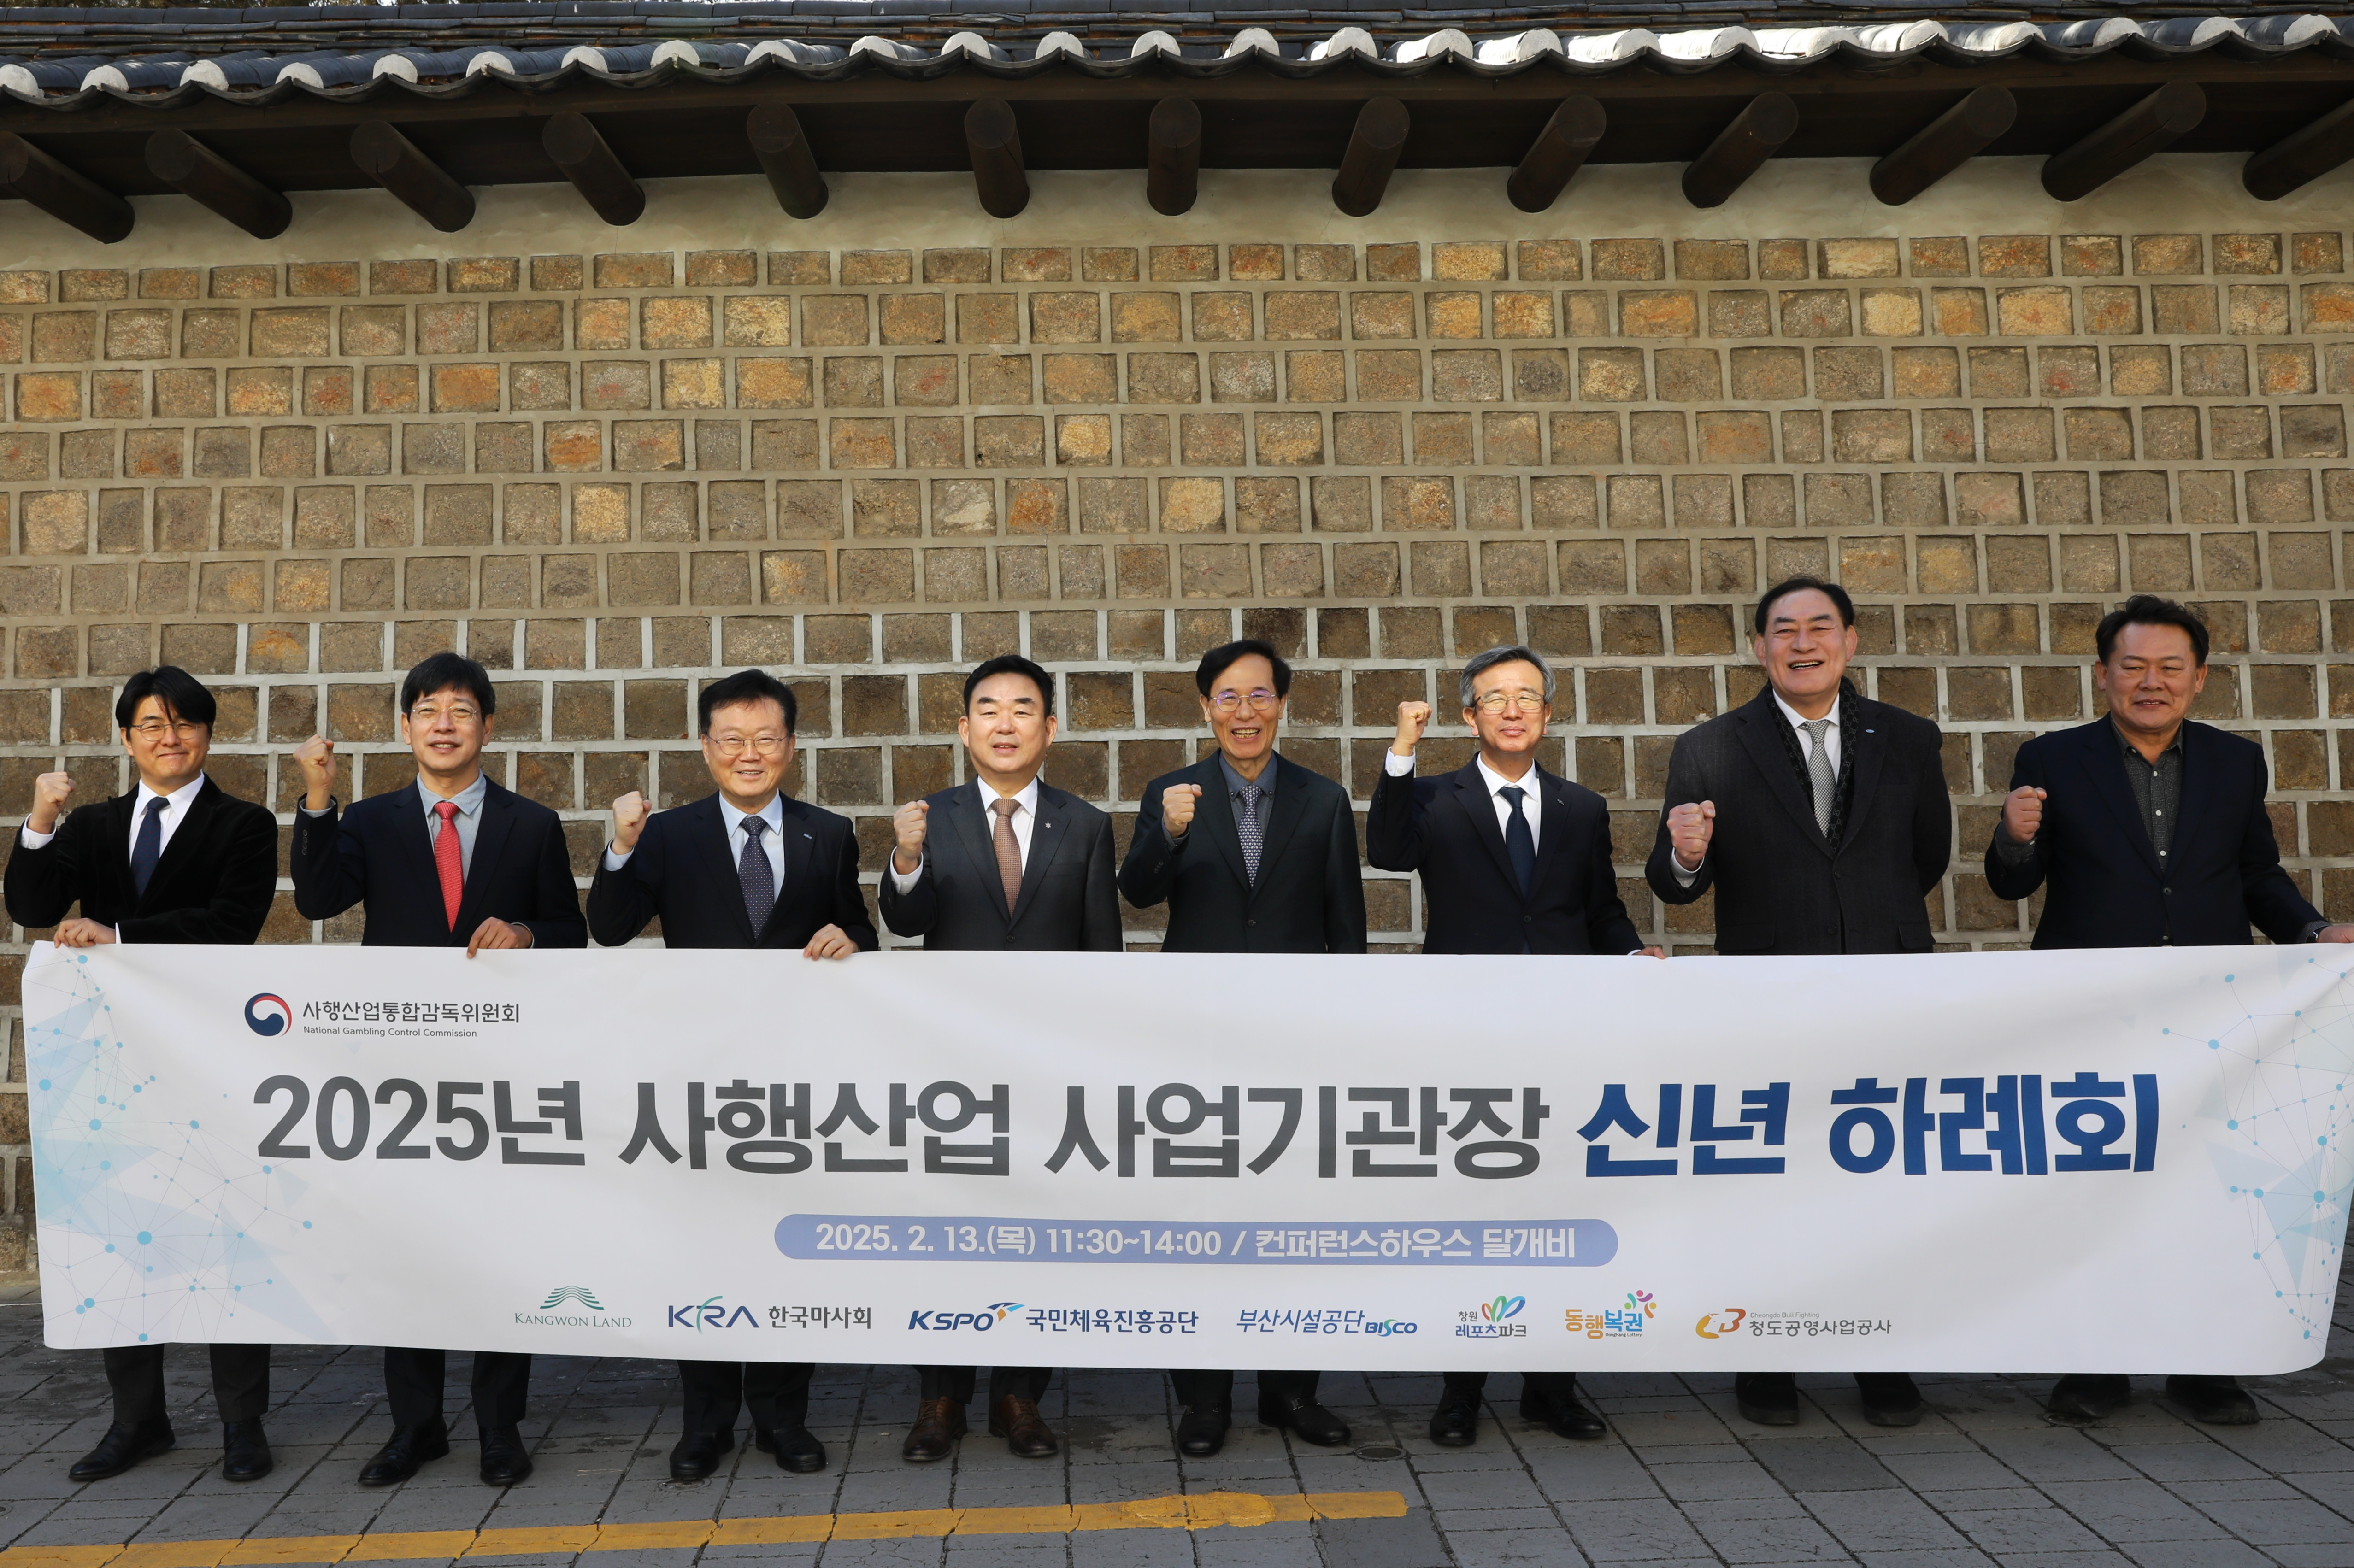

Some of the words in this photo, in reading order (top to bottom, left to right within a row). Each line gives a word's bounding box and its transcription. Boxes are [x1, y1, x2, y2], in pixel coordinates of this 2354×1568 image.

[302, 1001, 519, 1023] 사행산업통합감독위원회
[304, 1026, 340, 1035] National
[342, 1027, 385, 1037] Gambling
[388, 1028, 420, 1036] Control
[423, 1028, 477, 1037] Commission
[253, 1075, 586, 1166] 2025년
[618, 1079, 1010, 1176] 사행산업
[1043, 1082, 1550, 1180] 사업기관장
[1576, 1082, 1791, 1178] 신년
[1829, 1072, 2159, 1175] 하례회
[816, 1223, 898, 1251] 2025.
[908, 1225, 934, 1251] 2.
[944, 1225, 1036, 1255] 13.(목)
[1046, 1229, 1221, 1256] 11:30~14:00
[1230, 1230, 1247, 1256] /
[1255, 1228, 1472, 1258] 컨퍼런스하우스
[1483, 1228, 1575, 1258] 달개비
[514, 1312, 588, 1327] KANGWON
[593, 1315, 632, 1327] LAND
[668, 1295, 760, 1334] KRA
[768, 1306, 871, 1329] 한국마사회
[908, 1310, 994, 1332] KSPO
[1025, 1308, 1199, 1334] 국민체육진흥공단
[1236, 1309, 1365, 1334] 부산시설공단
[1365, 1319, 1418, 1337] BISCO
[1458, 1311, 1478, 1322] 창원
[1565, 1309, 1642, 1339] 동행복권
[1455, 1323, 1526, 1338] 레포츠파크
[1749, 1319, 1892, 1337] 청도공영사업공사
